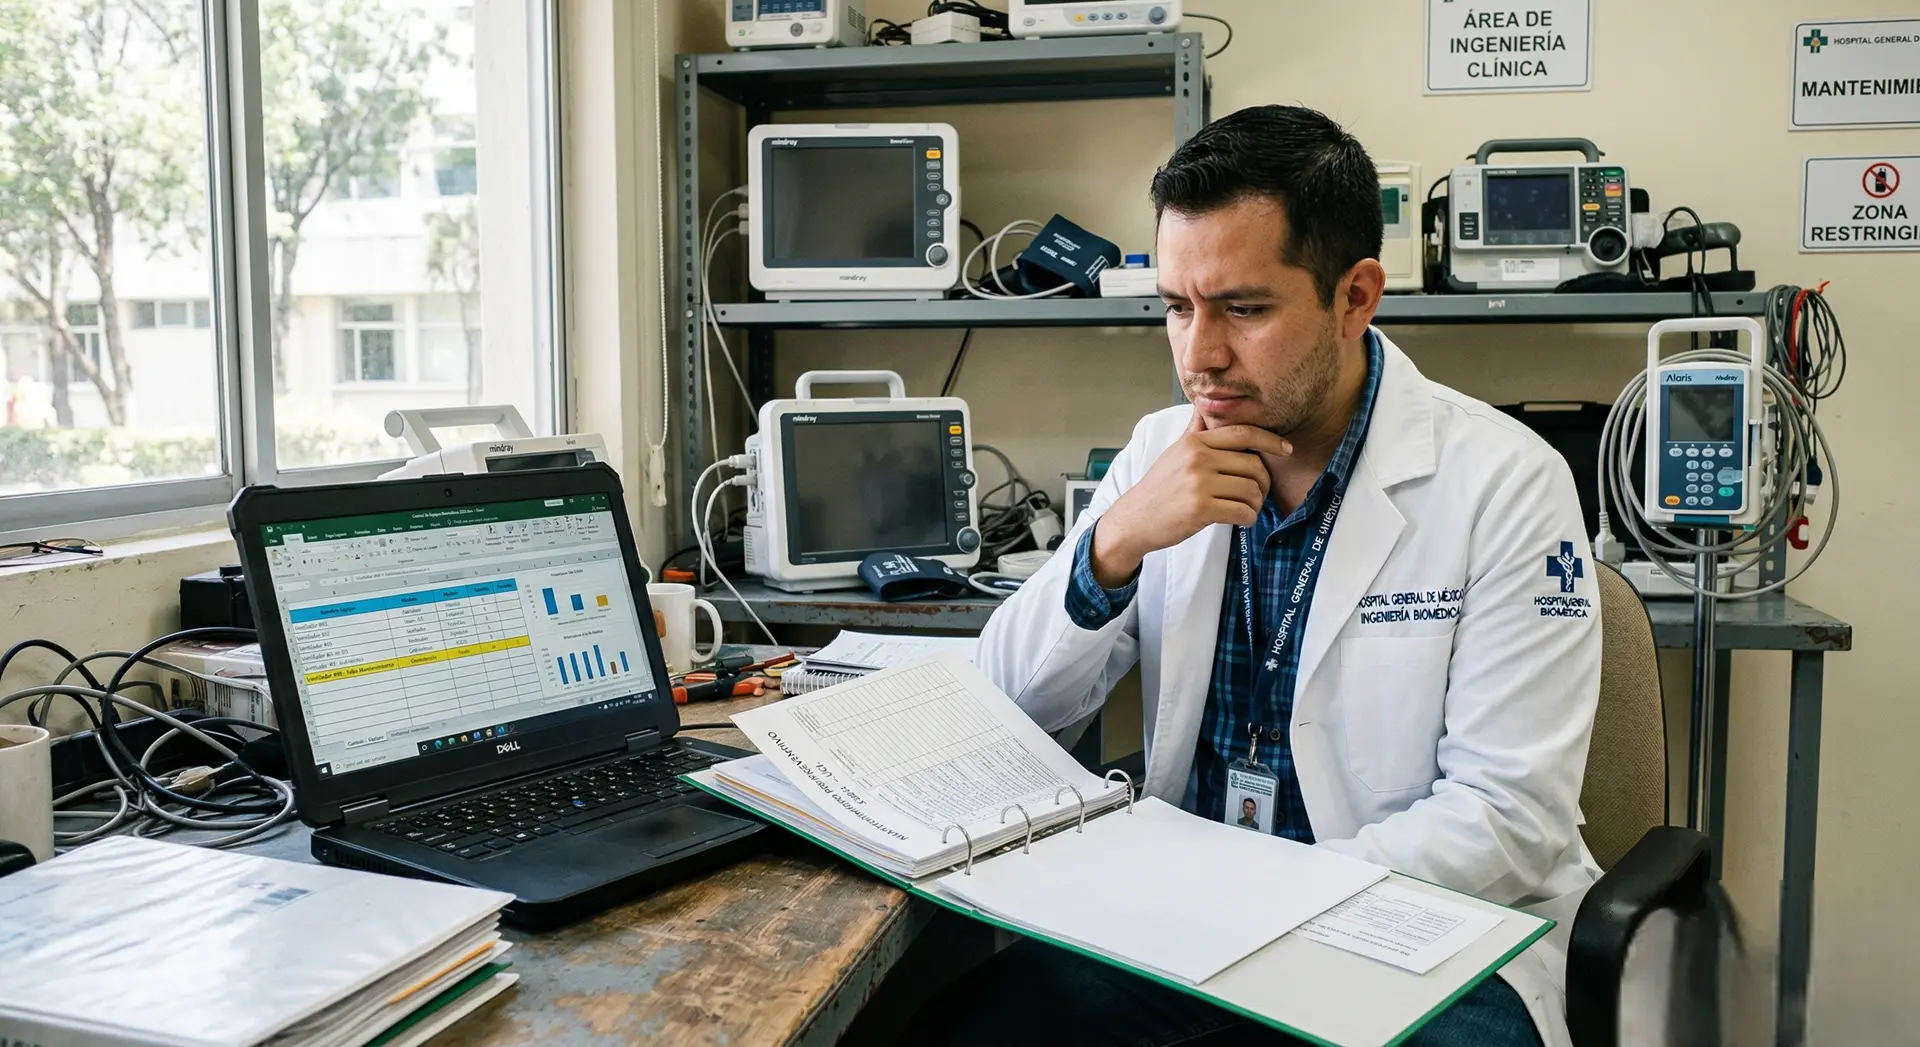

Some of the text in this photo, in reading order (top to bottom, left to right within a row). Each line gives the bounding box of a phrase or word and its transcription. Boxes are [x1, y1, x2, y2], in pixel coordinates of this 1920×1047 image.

[1463, 8, 1553, 29] ÁREA DE
[1450, 30, 1566, 54] INGENIERÍA
[1833, 36, 1872, 45] HOSPITAL
[1874, 35, 1912, 44] GENERAL
[1467, 58, 1548, 78] CLÍNICA
[1852, 204, 1908, 220] ZONA
[1811, 225, 1920, 242] RESTRINGI
[1666, 374, 1692, 382] Alaris
[489, 444, 514, 454] mindray
[1272, 607, 1296, 655] HOSPITAL
[1312, 535, 1325, 552] DE
[1357, 594, 1389, 608] OSPITAL
[1391, 592, 1426, 606] GENERAL
[1427, 591, 1436, 603] DE
[1360, 606, 1410, 624] INGENIERÍA
[496, 740, 522, 754] DELL
